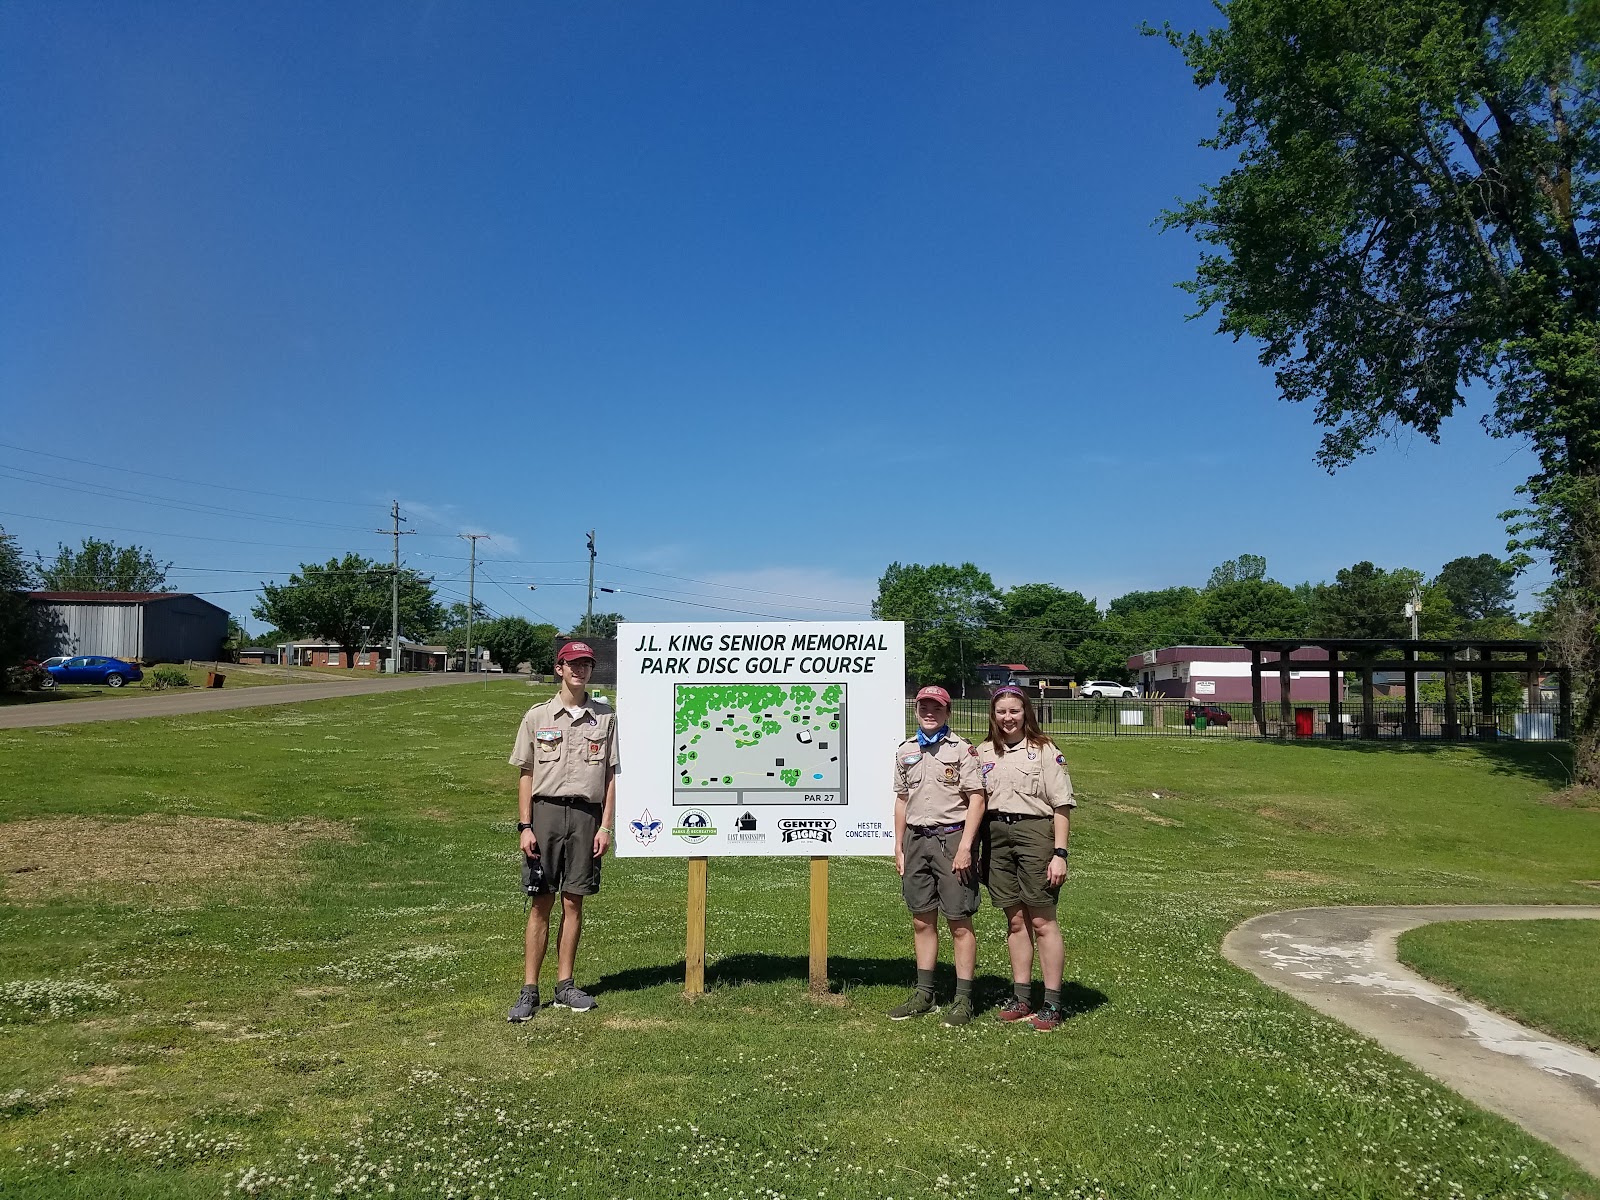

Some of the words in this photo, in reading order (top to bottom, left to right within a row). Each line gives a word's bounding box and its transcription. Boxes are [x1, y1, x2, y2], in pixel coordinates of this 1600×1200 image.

[634, 635, 662, 652] J.L.
[669, 635, 713, 651] KING
[719, 635, 786, 651] SENIOR
[791, 634, 888, 651] MEMORIAL
[641, 658, 691, 674] PARK
[696, 658, 740, 674] DISC
[746, 657, 795, 673] GOLF
[800, 656, 876, 674] COURSE
[790, 830, 824, 840] SIGNS
